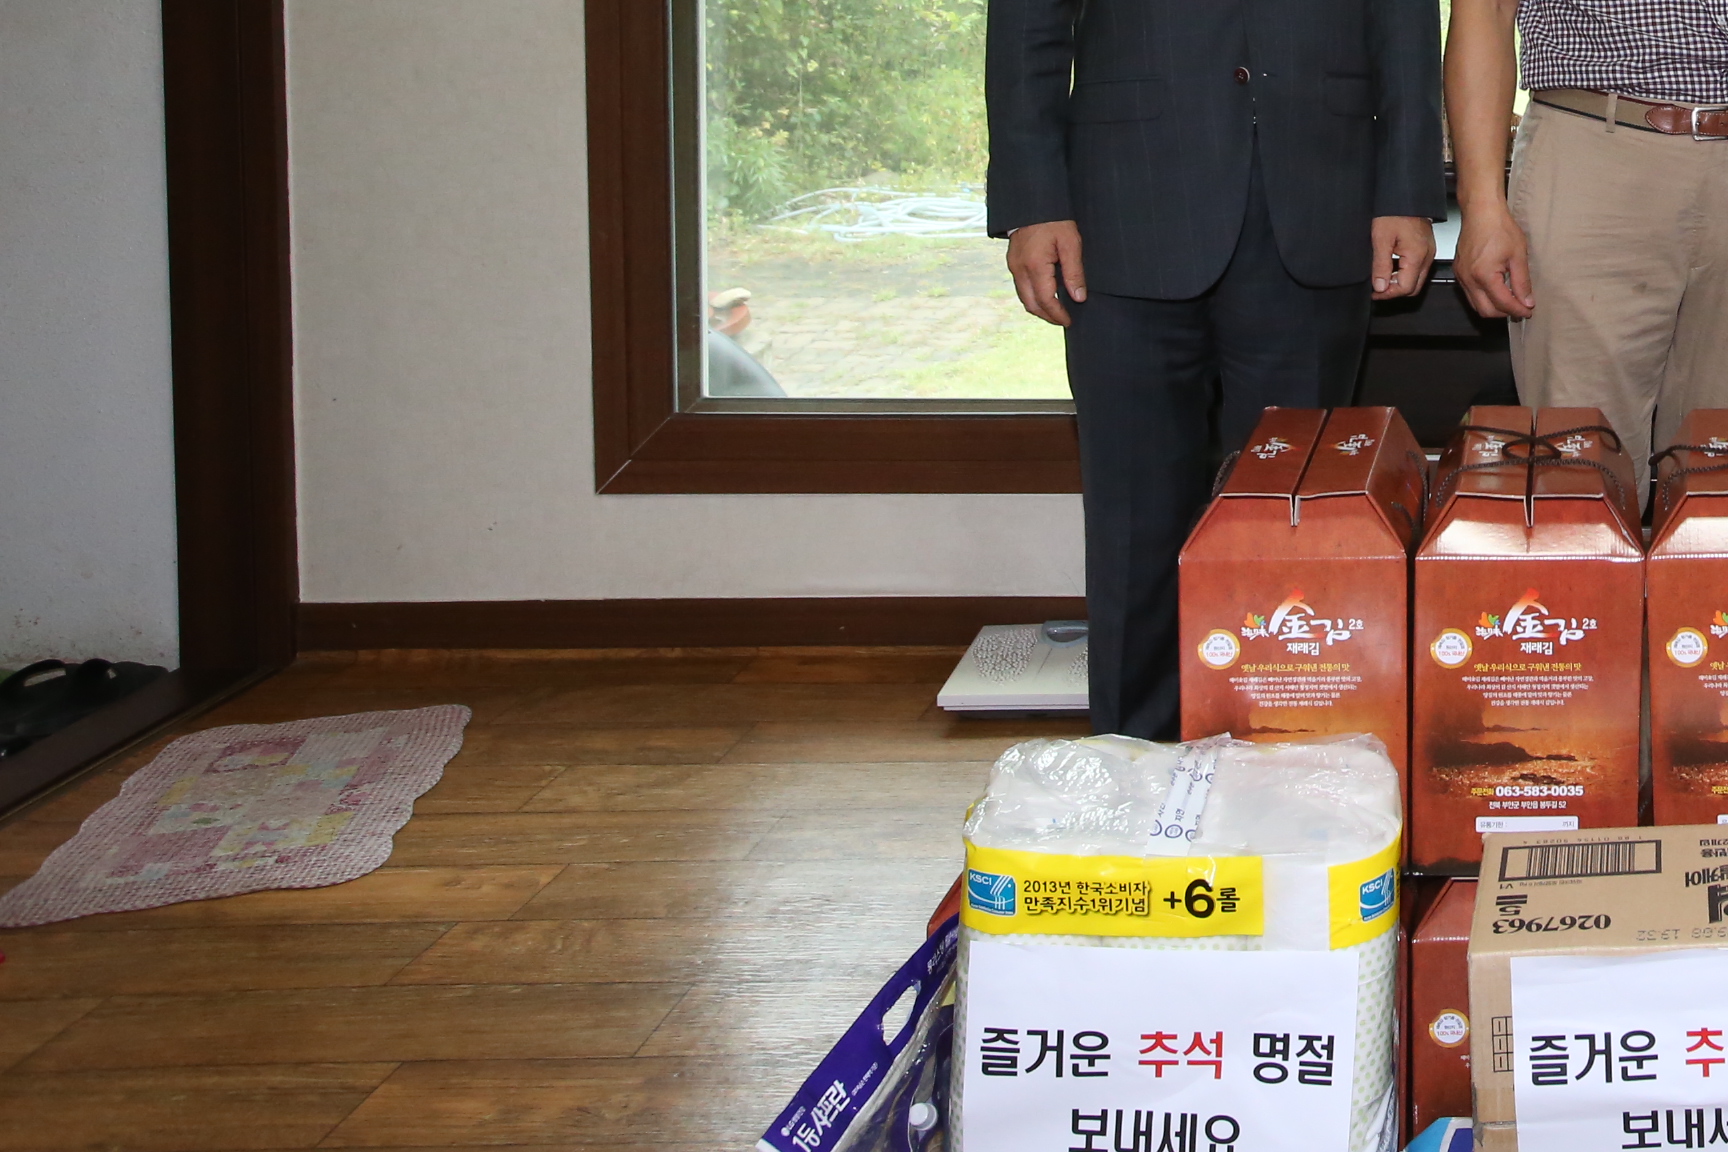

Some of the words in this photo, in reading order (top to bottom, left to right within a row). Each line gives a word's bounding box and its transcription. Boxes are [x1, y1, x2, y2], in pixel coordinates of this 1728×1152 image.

[1348, 619, 1364, 630] 2호
[1582, 618, 1598, 630] 2호
[1286, 642, 1320, 656] 재래김
[1520, 642, 1553, 655] 재래김
[1495, 785, 1584, 797] 063-583-0035
[1558, 801, 1567, 810] 52
[969, 872, 992, 887] KSCI
[1362, 879, 1383, 895] KSCI
[1023, 880, 1072, 895] 2013년
[1076, 880, 1148, 896] 한국소비자
[1024, 896, 1146, 913] 만족지수1위기념
[1492, 913, 1612, 934] 0267963
[979, 1027, 1112, 1079] 즐거운
[1138, 1030, 1225, 1080] 추석
[1252, 1032, 1335, 1086] 명절
[1528, 1029, 1658, 1086] 즐거운
[1069, 1108, 1241, 1152] 보내세요
